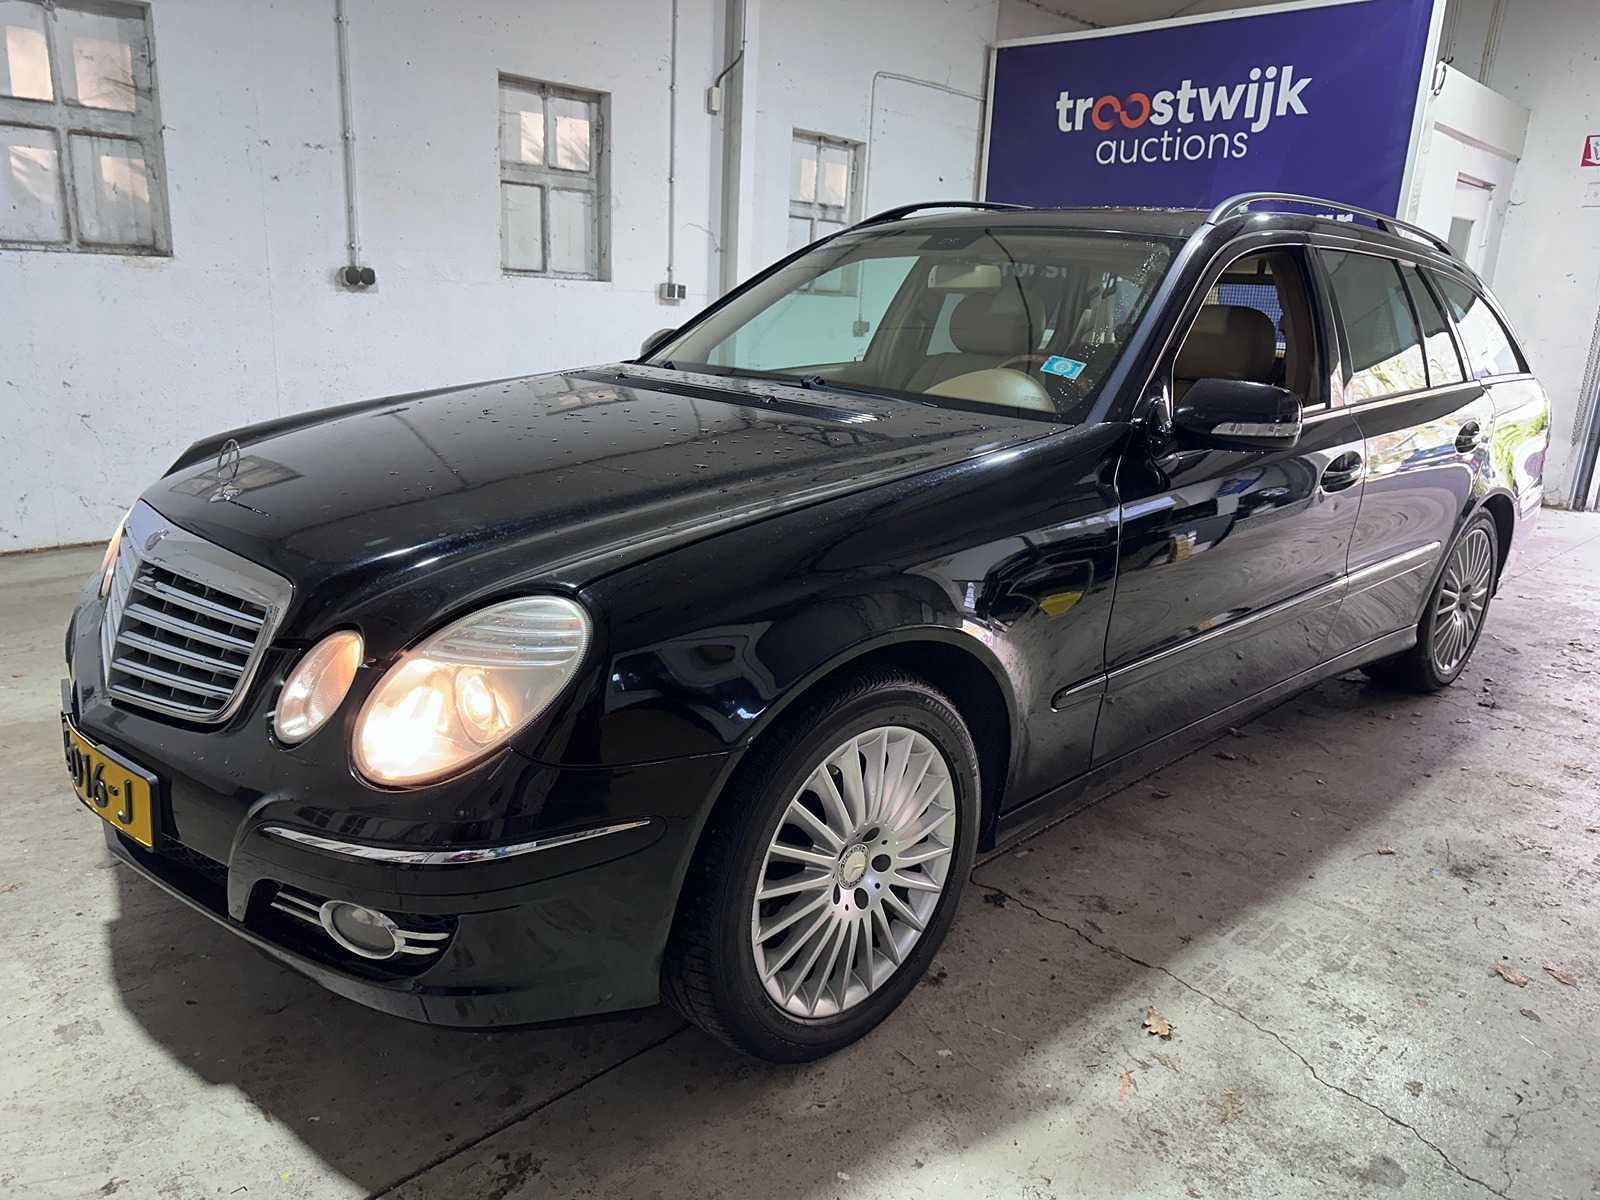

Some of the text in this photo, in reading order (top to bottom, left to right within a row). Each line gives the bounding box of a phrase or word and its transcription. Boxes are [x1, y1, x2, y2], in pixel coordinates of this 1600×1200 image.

[1056, 65, 1313, 133] troostwijk
[1095, 128, 1249, 164] auctions
[65, 730, 134, 825] 016-J
